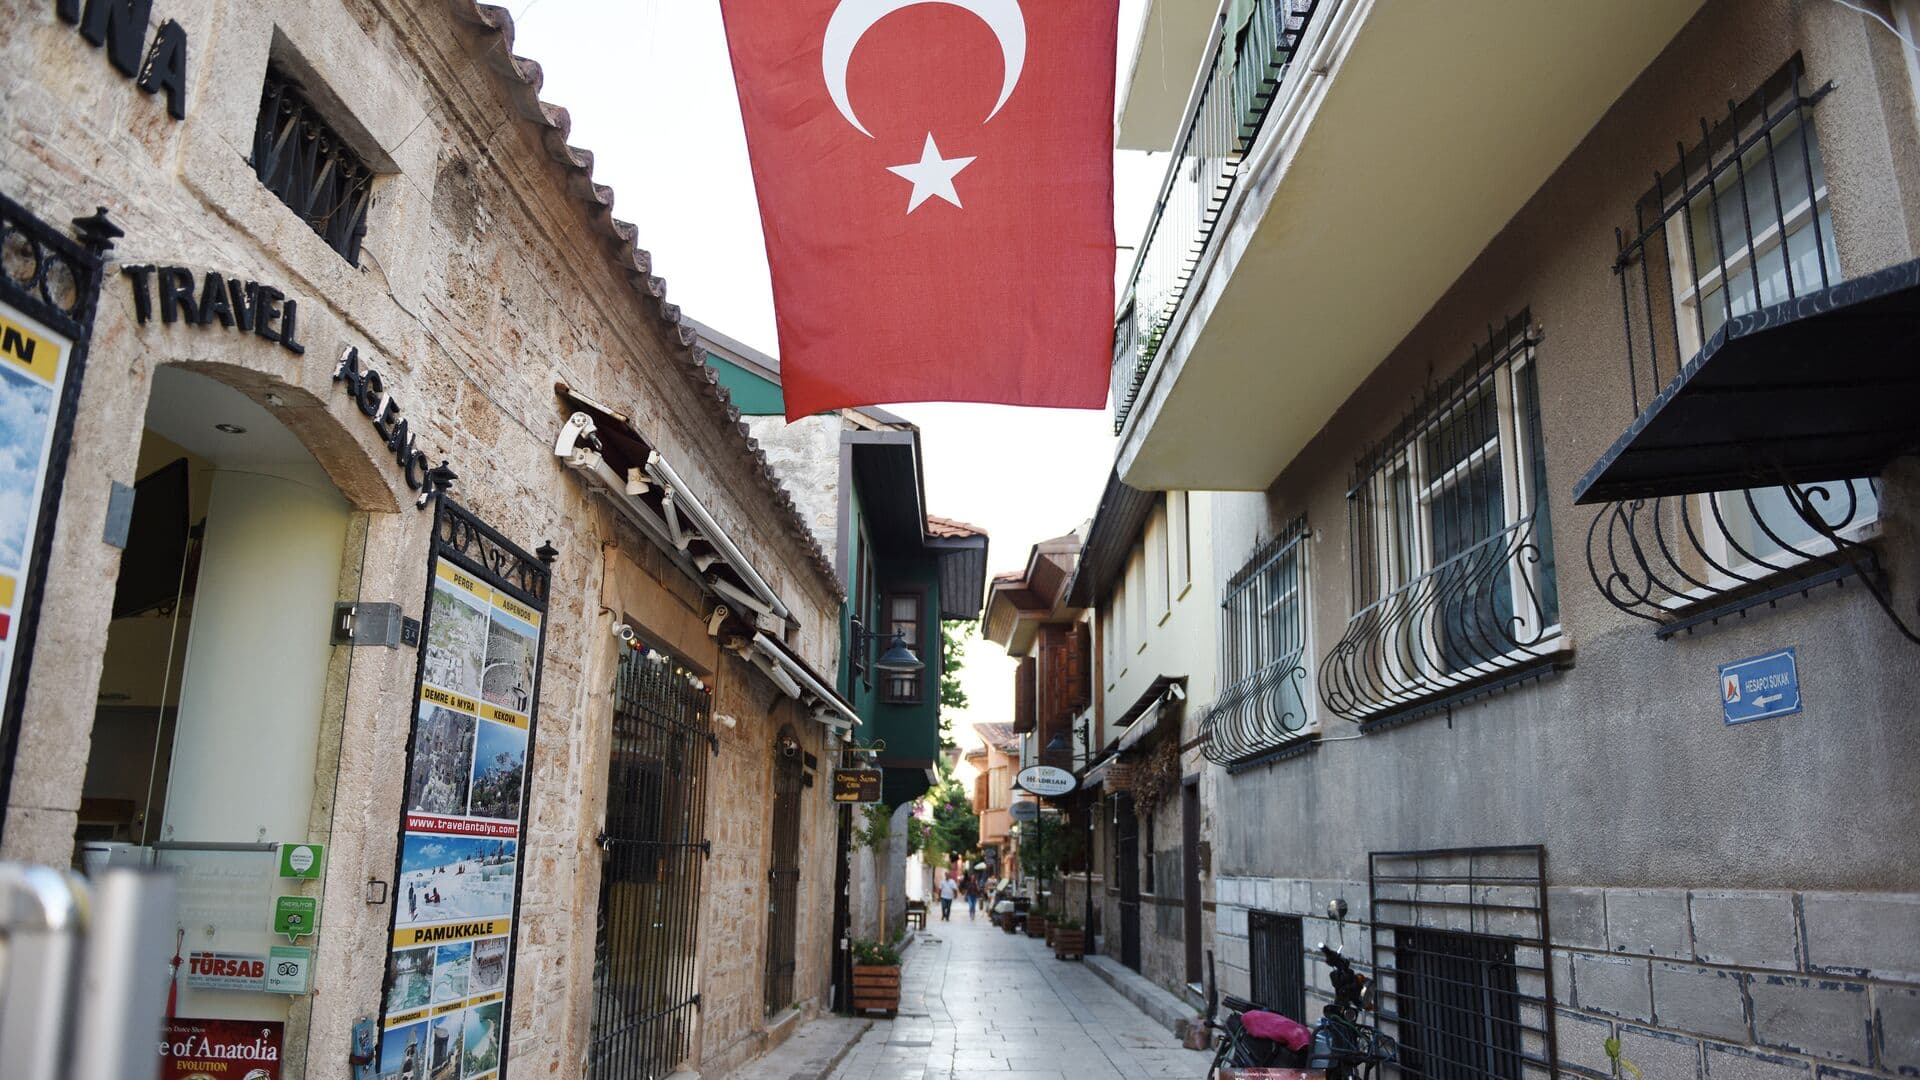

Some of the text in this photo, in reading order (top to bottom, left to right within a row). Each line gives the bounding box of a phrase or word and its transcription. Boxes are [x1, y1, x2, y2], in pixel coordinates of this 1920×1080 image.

[57, 0, 187, 120] NA
[121, 263, 304, 354] TRAVEL
[0, 326, 36, 365] N
[453, 573, 474, 592] PERGE
[502, 600, 531, 621] ASPENDOS
[1769, 672, 1789, 688] SOKAK
[424, 688, 449, 704] DEMRE
[456, 698, 475, 713] MYRA
[493, 709, 516, 724] KEKOVA
[409, 818, 515, 835] www.travelantalya.com
[414, 922, 494, 943] PAMUKKALE
[189, 952, 265, 978] TÜRSAB
[173, 1036, 196, 1057] of
[195, 1036, 278, 1061] Anatolia
[176, 1060, 228, 1072] EVOLUTION
